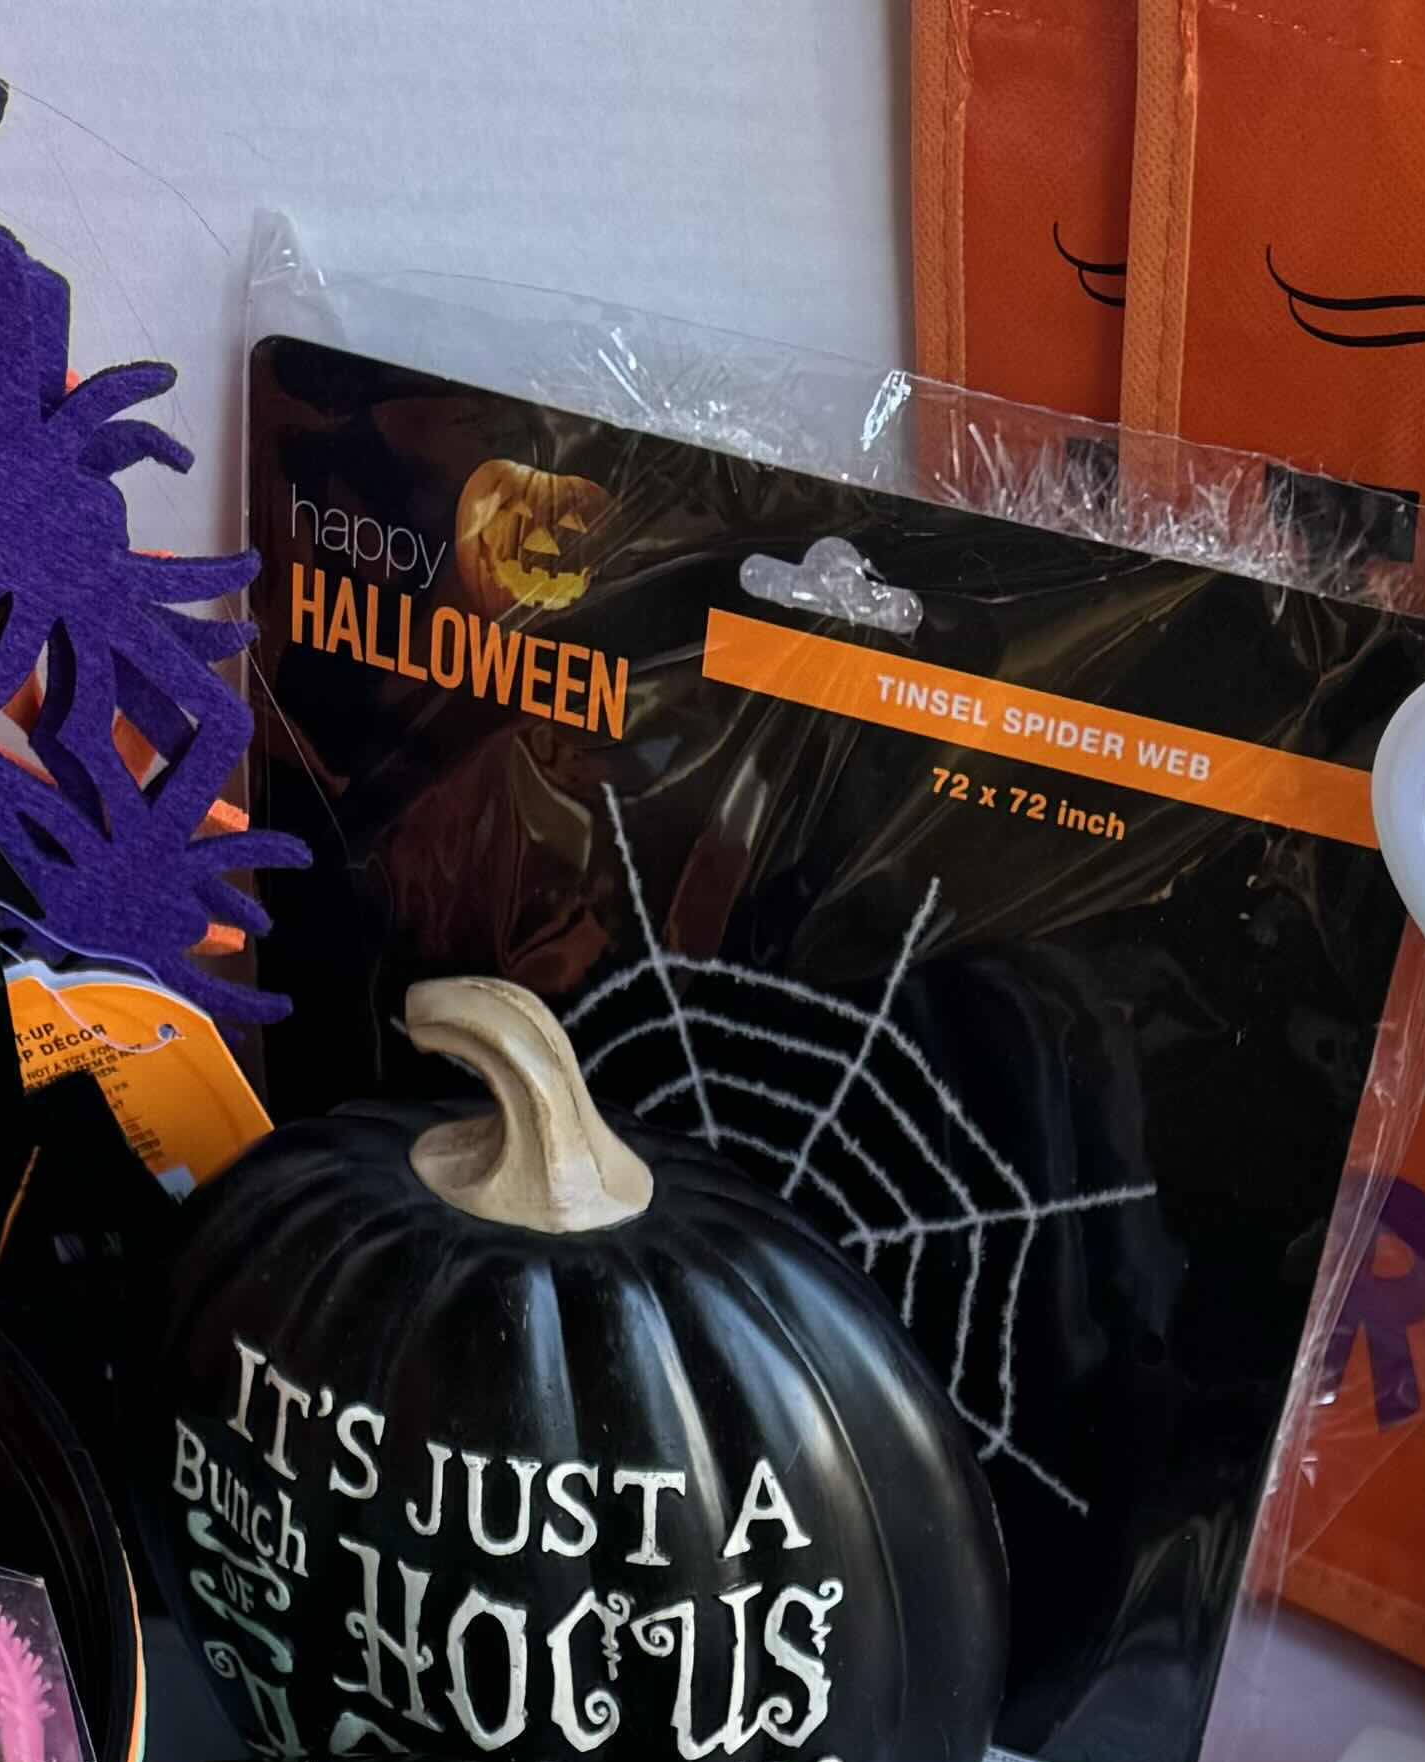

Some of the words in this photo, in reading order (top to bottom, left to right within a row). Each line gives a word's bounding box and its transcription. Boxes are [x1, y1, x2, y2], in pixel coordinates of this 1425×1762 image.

[290, 483, 447, 589] happy
[291, 562, 630, 741] HALLOWEEN
[877, 675, 990, 728] TINSEL
[1002, 706, 1126, 760] SPIDER
[1136, 739, 1212, 782] WEB
[931, 767, 969, 801] 72
[978, 785, 998, 808] x
[1009, 787, 1047, 821] 72
[1056, 799, 1126, 841] inch
[173, 1415, 309, 1578] Bunch
[226, 1335, 385, 1500] IT'S
[406, 1441, 686, 1566] JUST
[722, 1457, 812, 1560] A
[332, 1533, 844, 1762] HOCUS
